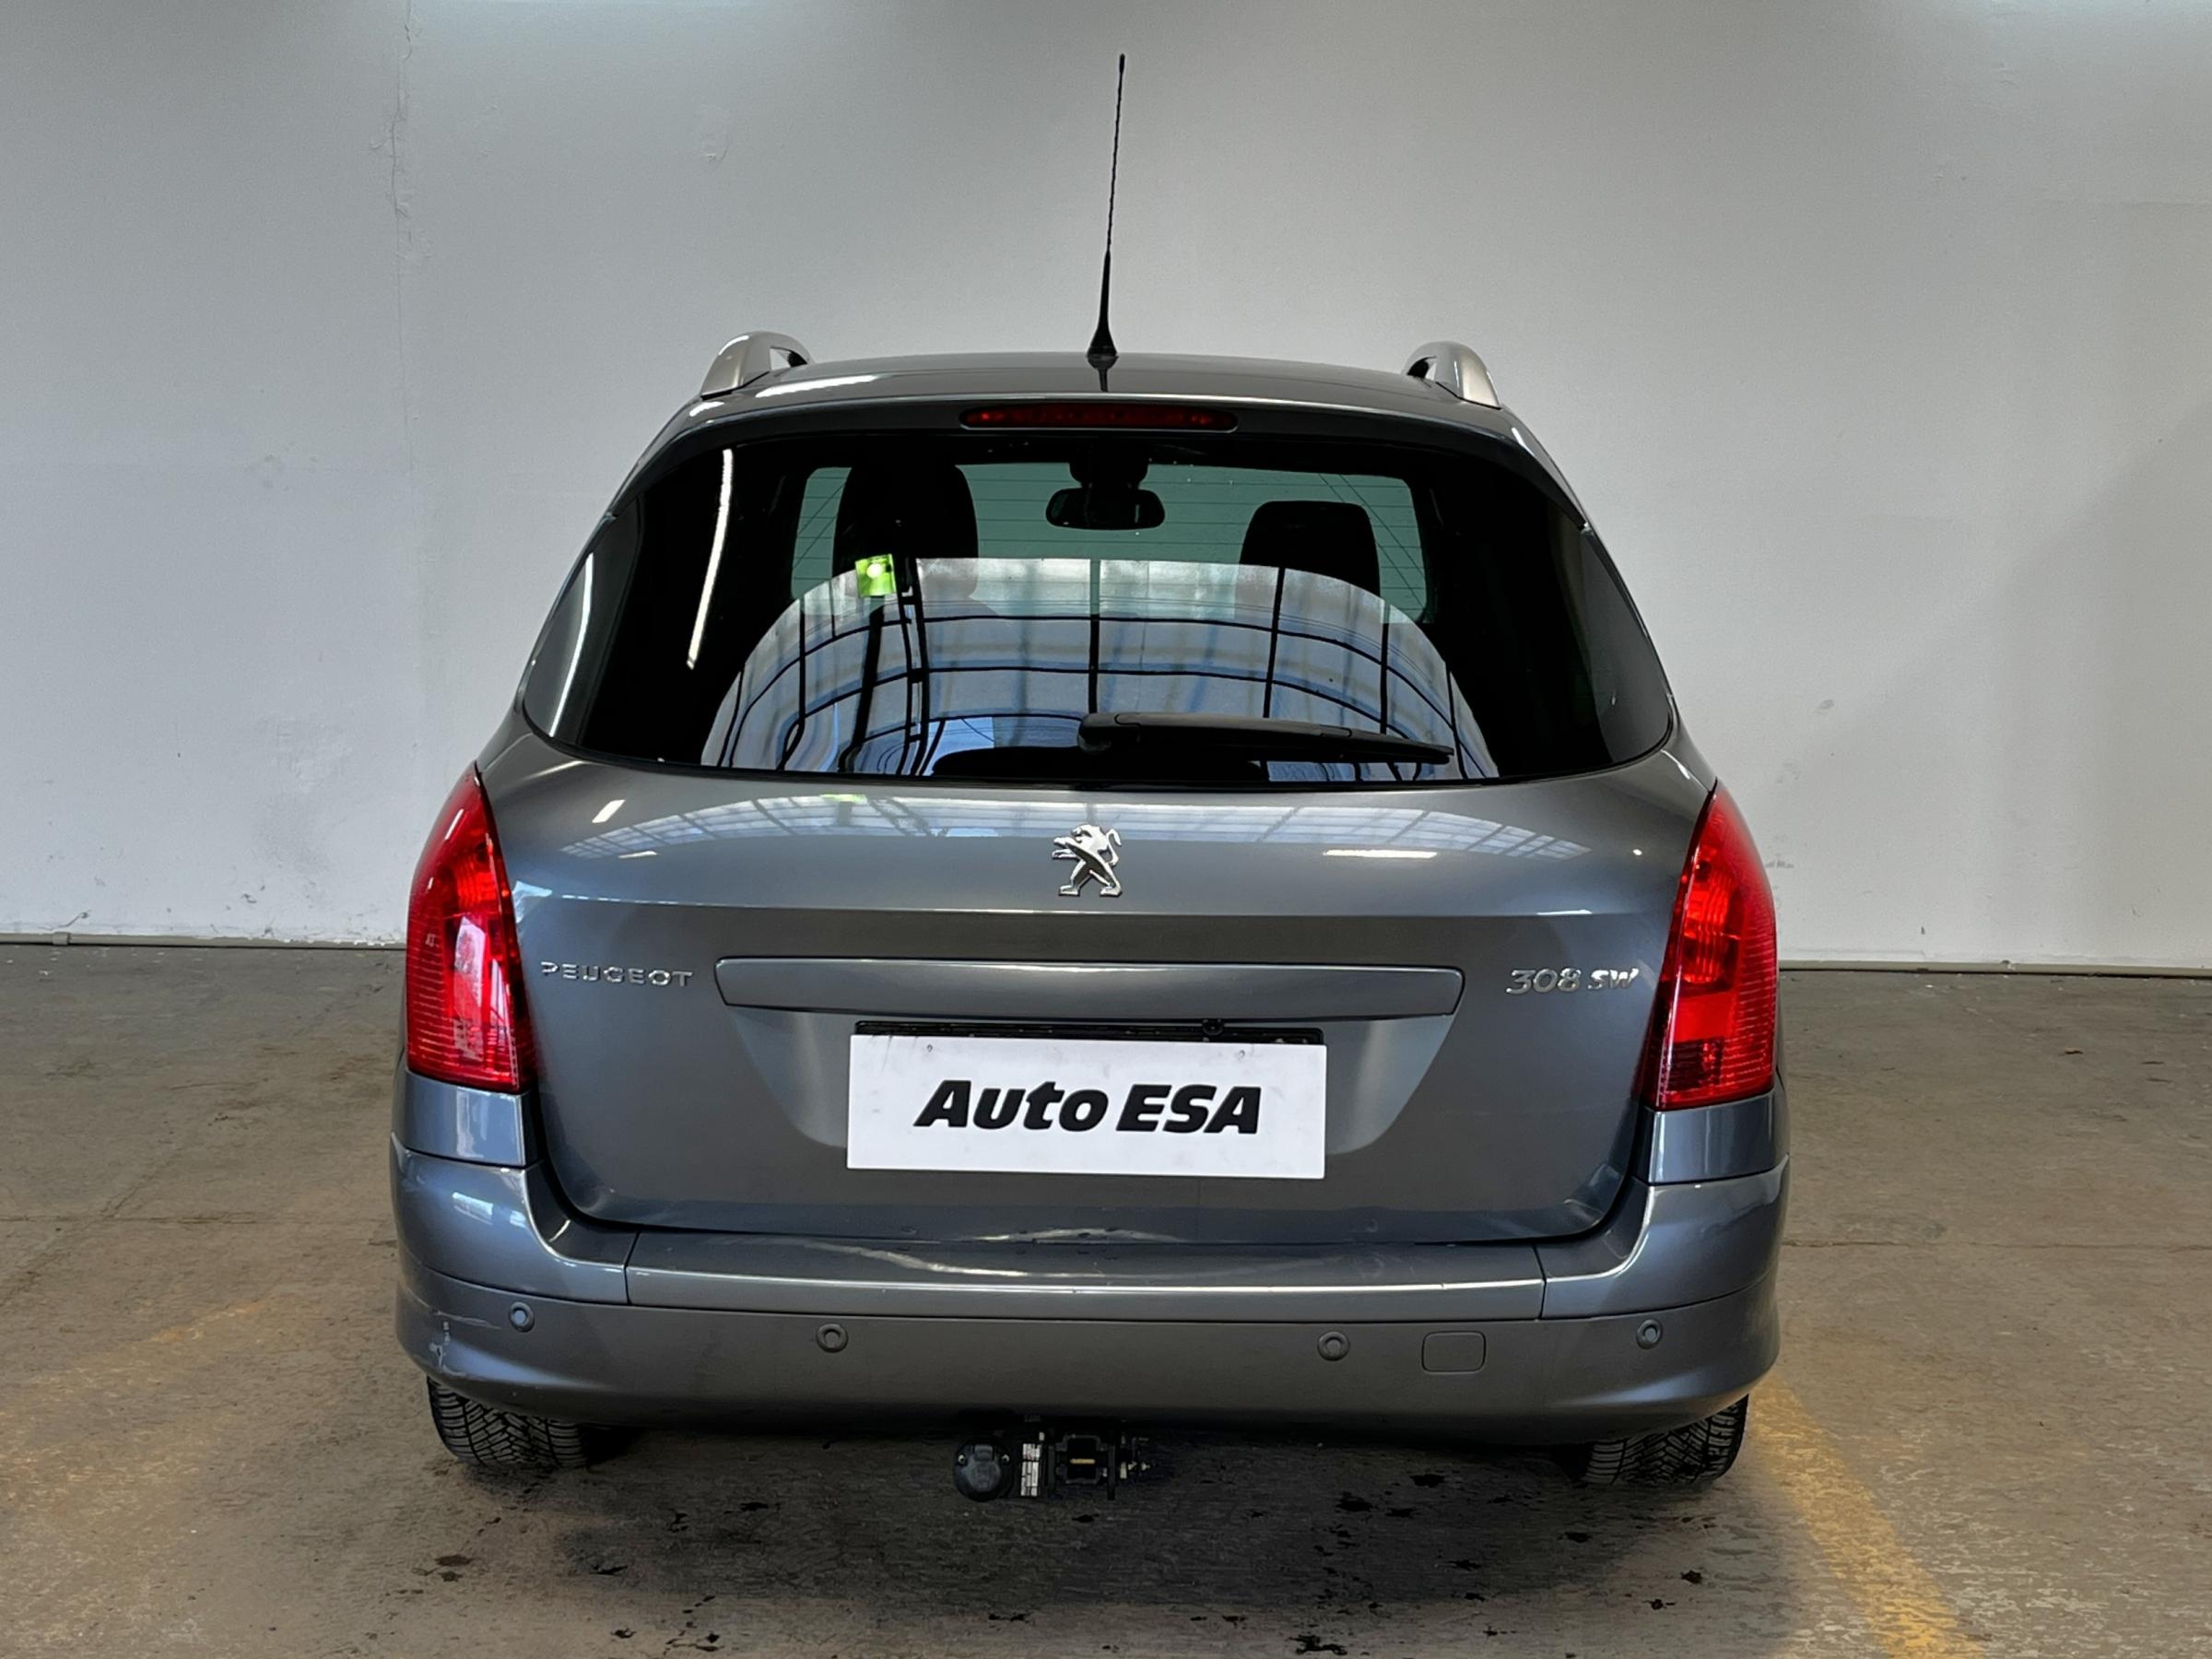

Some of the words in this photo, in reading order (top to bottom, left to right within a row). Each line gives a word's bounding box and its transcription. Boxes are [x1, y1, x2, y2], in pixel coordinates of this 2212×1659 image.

[540, 960, 693, 987] PEUGEOT
[1505, 967, 1582, 994] 308
[1587, 968, 1640, 990] SW
[912, 1079, 1110, 1133] Auto
[1115, 1084, 1262, 1135] ESA
